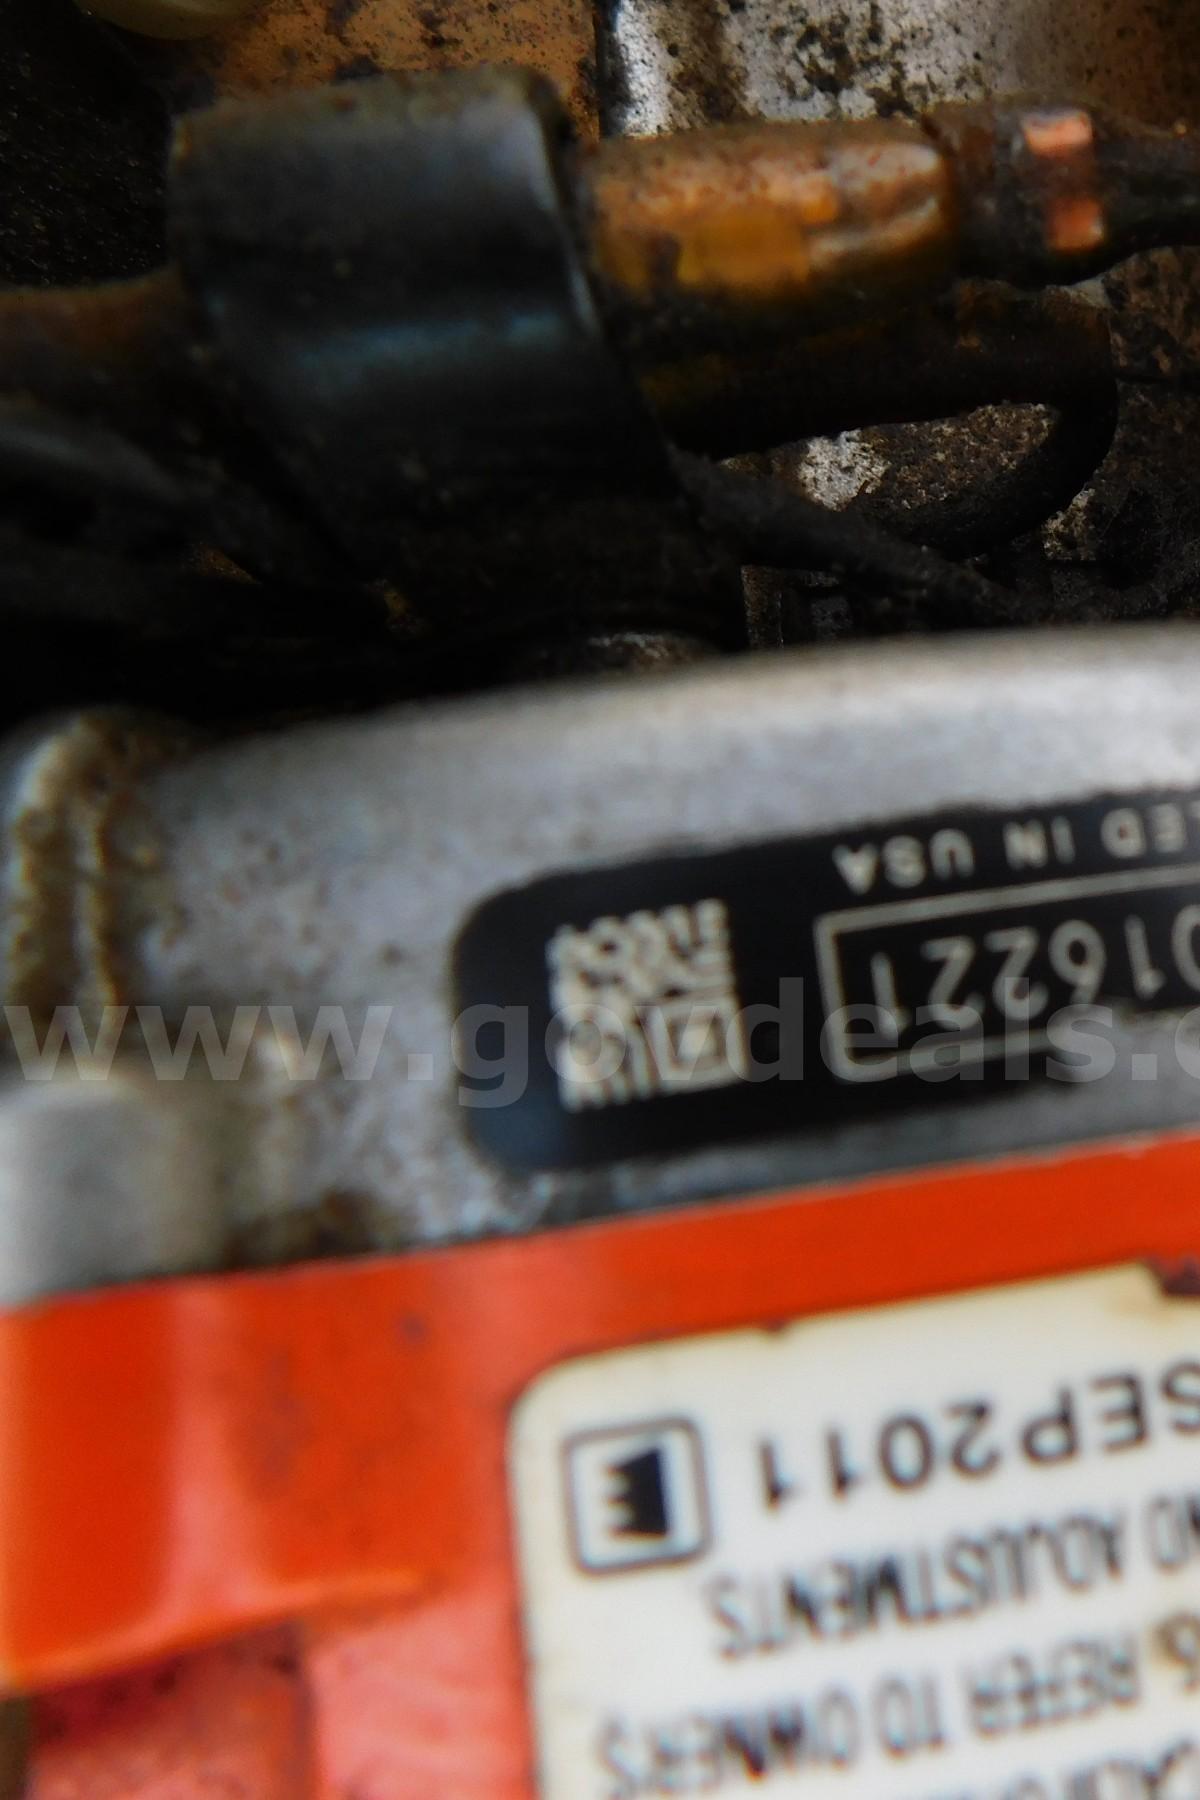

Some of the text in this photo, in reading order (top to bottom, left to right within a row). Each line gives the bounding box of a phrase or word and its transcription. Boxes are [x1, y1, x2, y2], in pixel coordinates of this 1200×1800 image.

[832, 828, 974, 896] USA
[1003, 815, 1075, 872] IN
[700, 1513, 1127, 1665] ADJUSTMENTS
[870, 1674, 947, 1763] TO
[964, 1634, 1142, 1742] REFER
